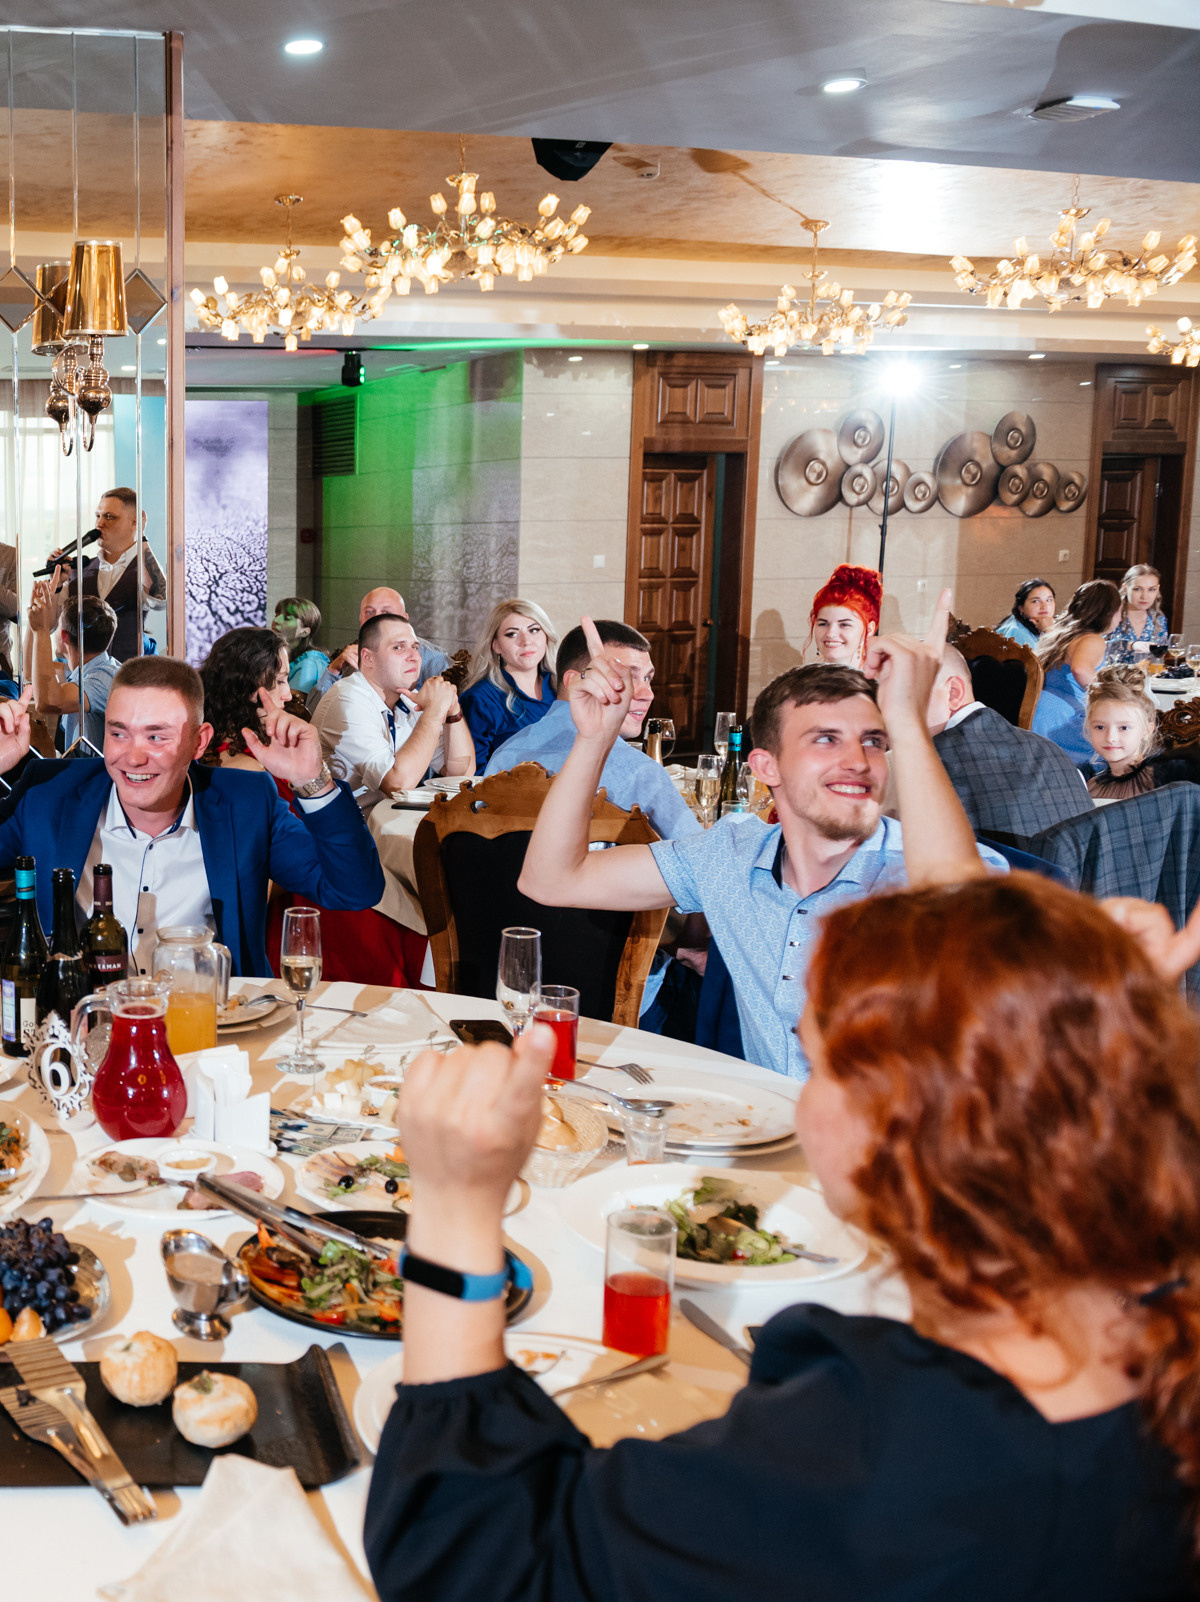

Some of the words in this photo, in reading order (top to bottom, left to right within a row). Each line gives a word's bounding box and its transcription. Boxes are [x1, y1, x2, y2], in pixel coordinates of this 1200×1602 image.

[89, 962, 122, 970] ERMAN
[23, 1020, 35, 1028] Go
[40, 1042, 71, 1098] 6
